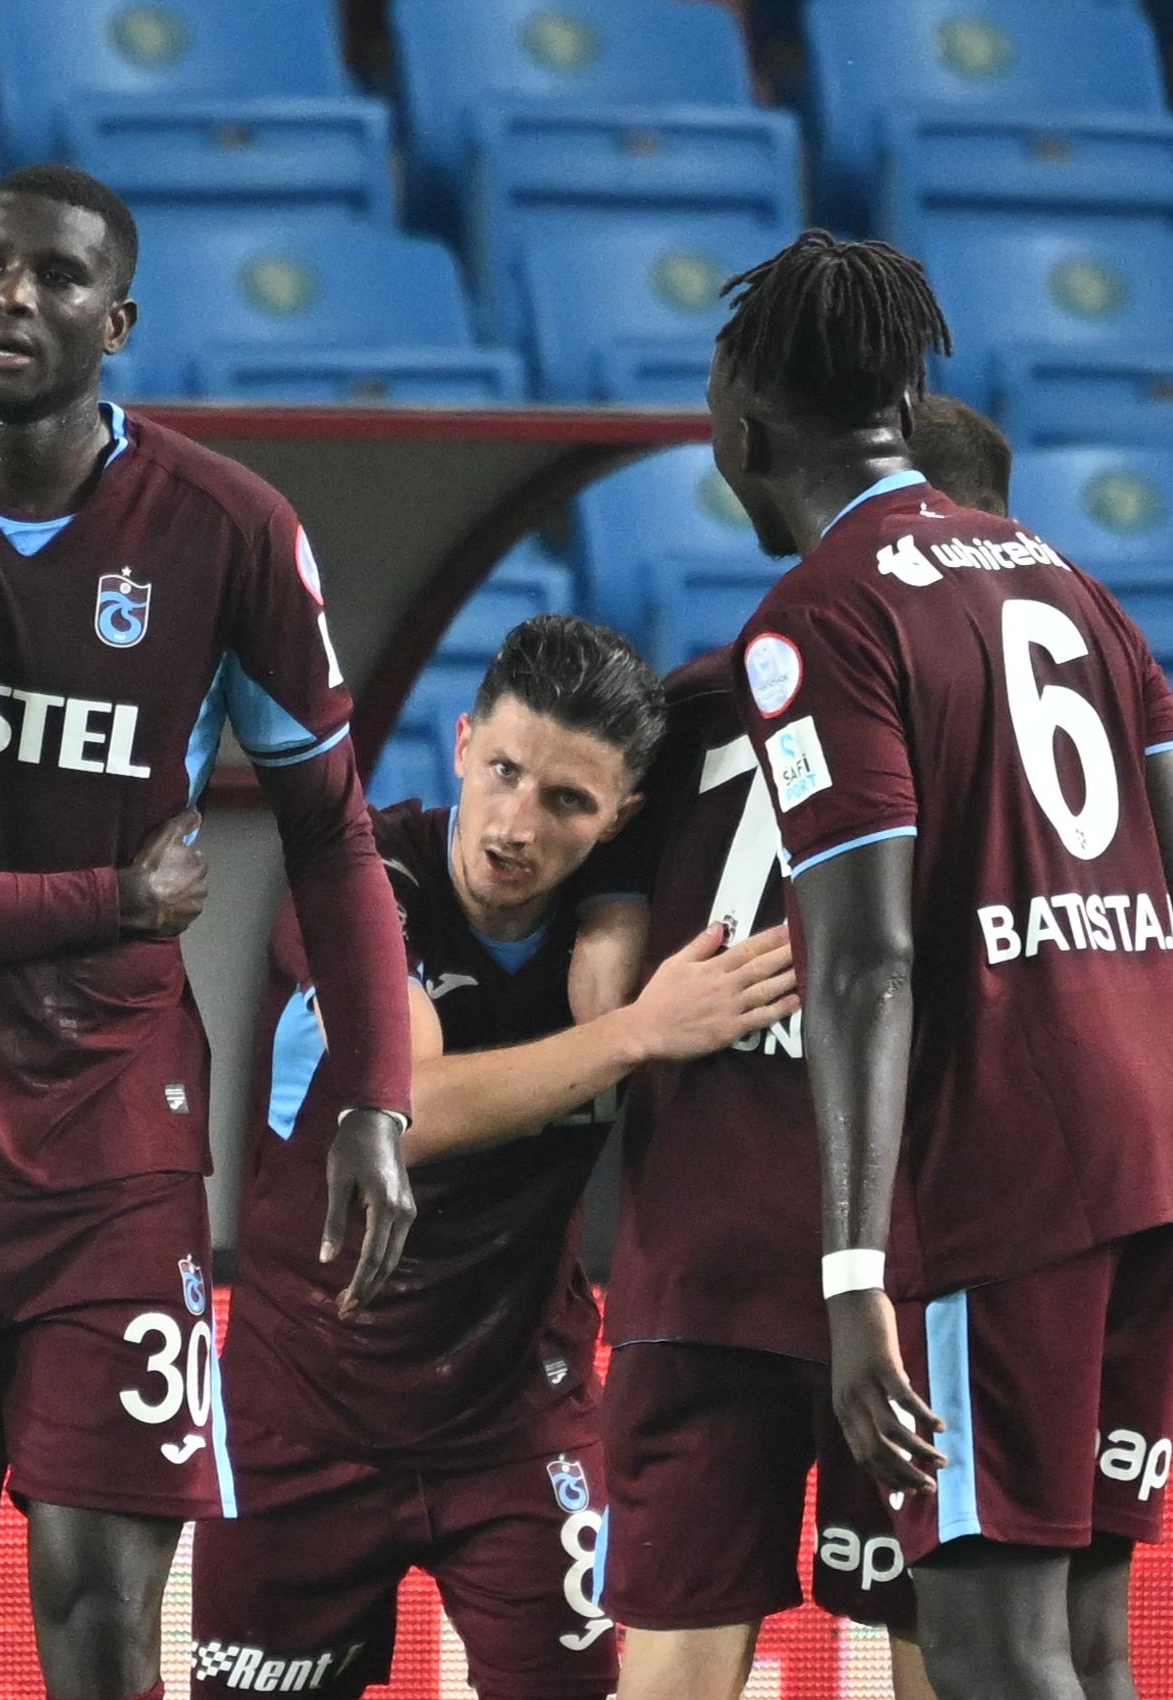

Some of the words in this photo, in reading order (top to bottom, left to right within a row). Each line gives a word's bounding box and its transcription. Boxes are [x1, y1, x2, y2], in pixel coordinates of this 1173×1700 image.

[930, 531, 1073, 571] whitebi
[1002, 599, 1121, 860] 6
[977, 892, 1173, 965] BATISTA.
[119, 1312, 212, 1428] 30
[560, 1510, 606, 1618] 8
[226, 1648, 334, 1692] Rent
